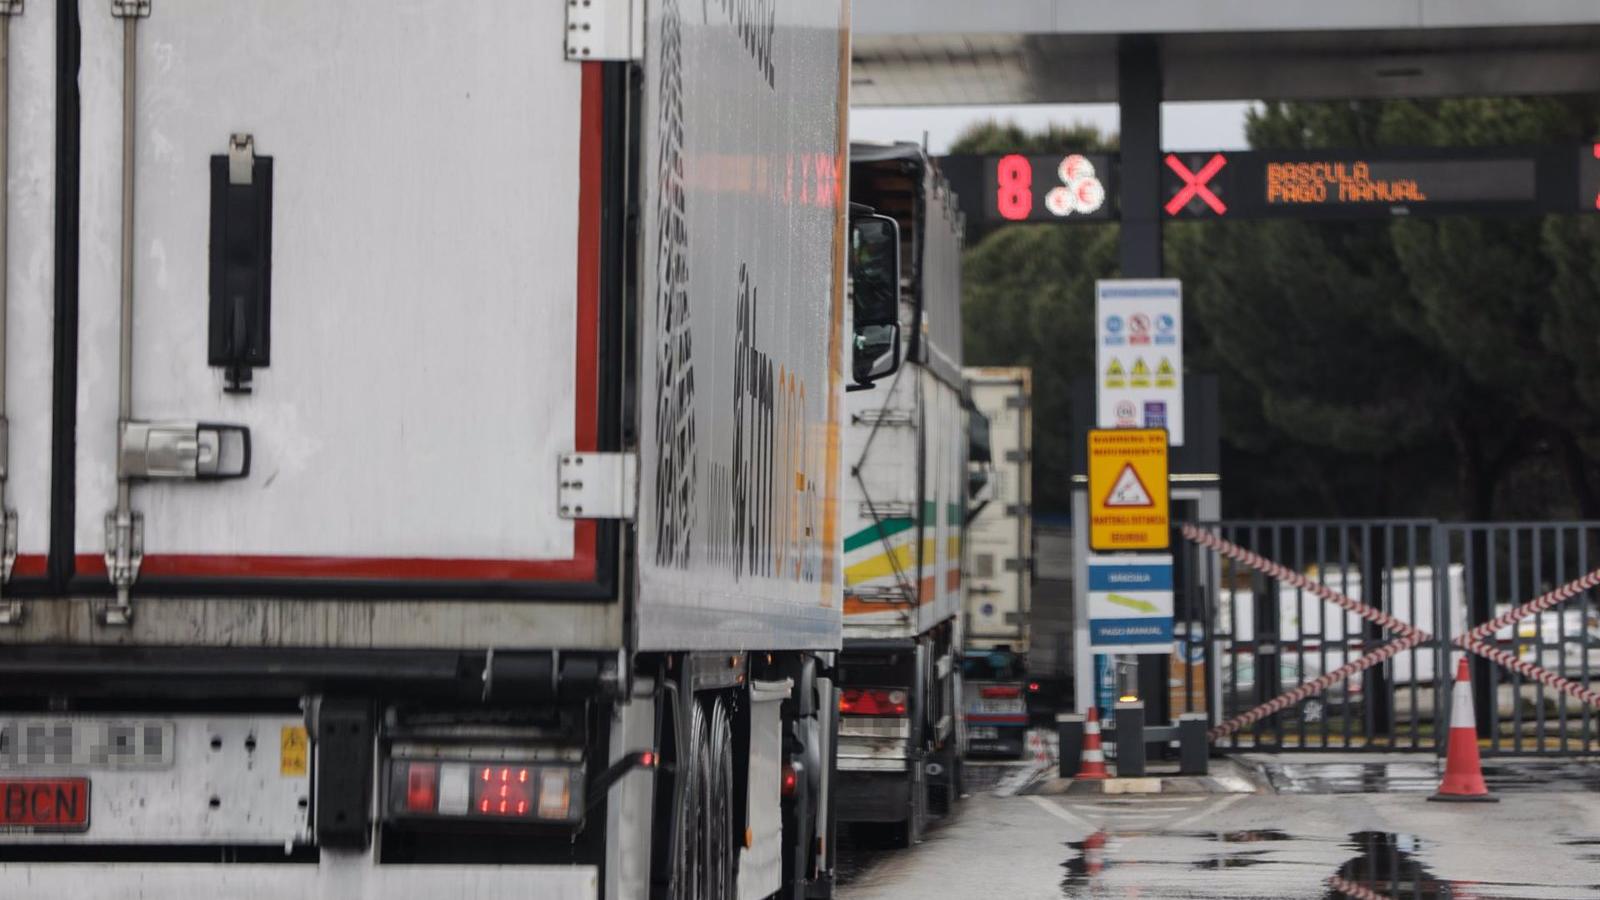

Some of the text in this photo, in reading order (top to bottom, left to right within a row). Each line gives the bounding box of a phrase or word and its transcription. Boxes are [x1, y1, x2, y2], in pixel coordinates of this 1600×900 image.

[997, 154, 1033, 220] 8
[1267, 161, 1370, 183] BASCULA
[1267, 179, 1426, 203] PAGO MANUAL
[5, 783, 78, 821] BCN
